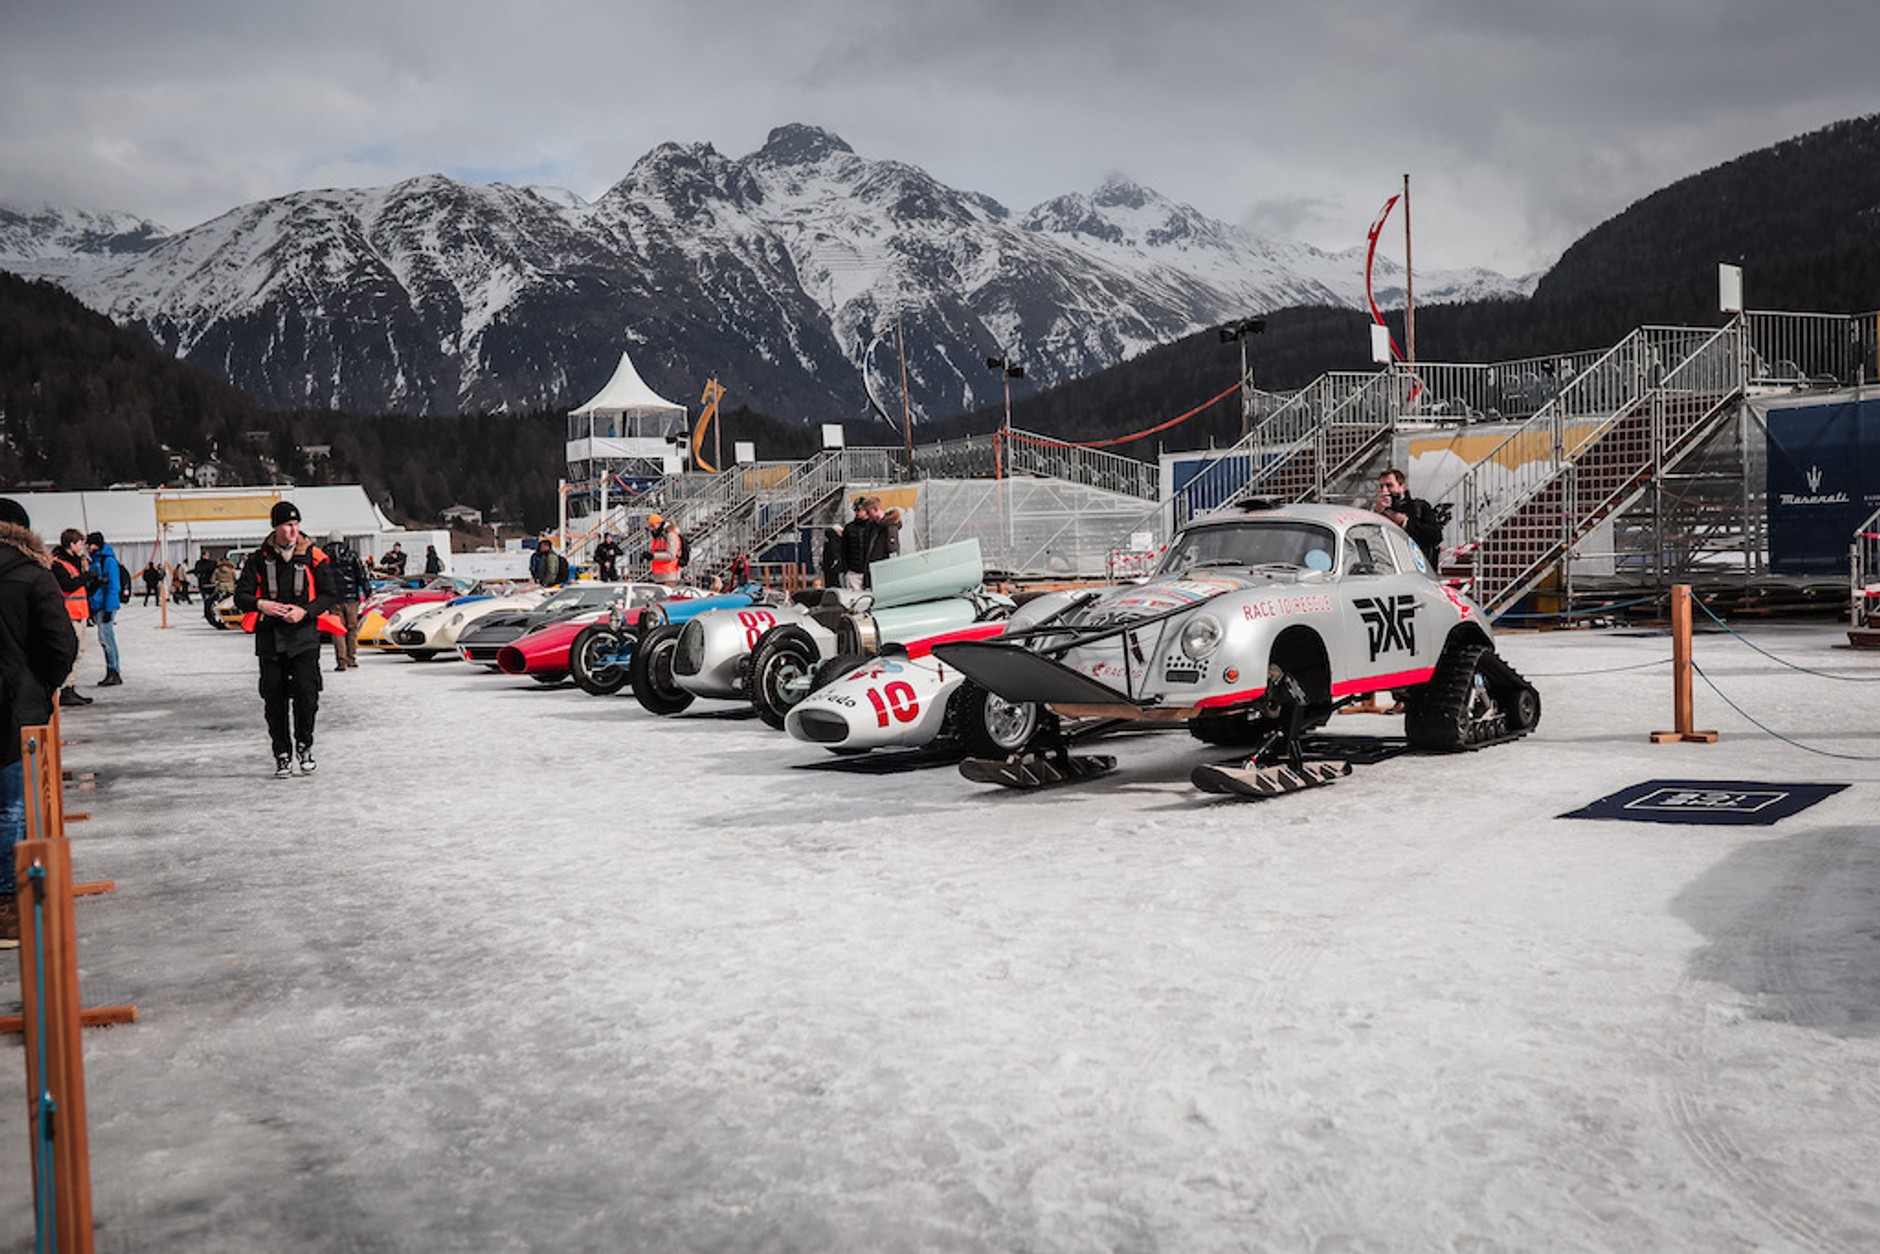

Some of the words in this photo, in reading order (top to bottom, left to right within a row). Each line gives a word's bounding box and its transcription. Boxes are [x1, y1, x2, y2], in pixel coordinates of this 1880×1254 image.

[1779, 492, 1850, 504] Maserati
[1243, 601, 1277, 621] RACE
[1277, 599, 1292, 615] TO
[867, 681, 919, 728] 10
